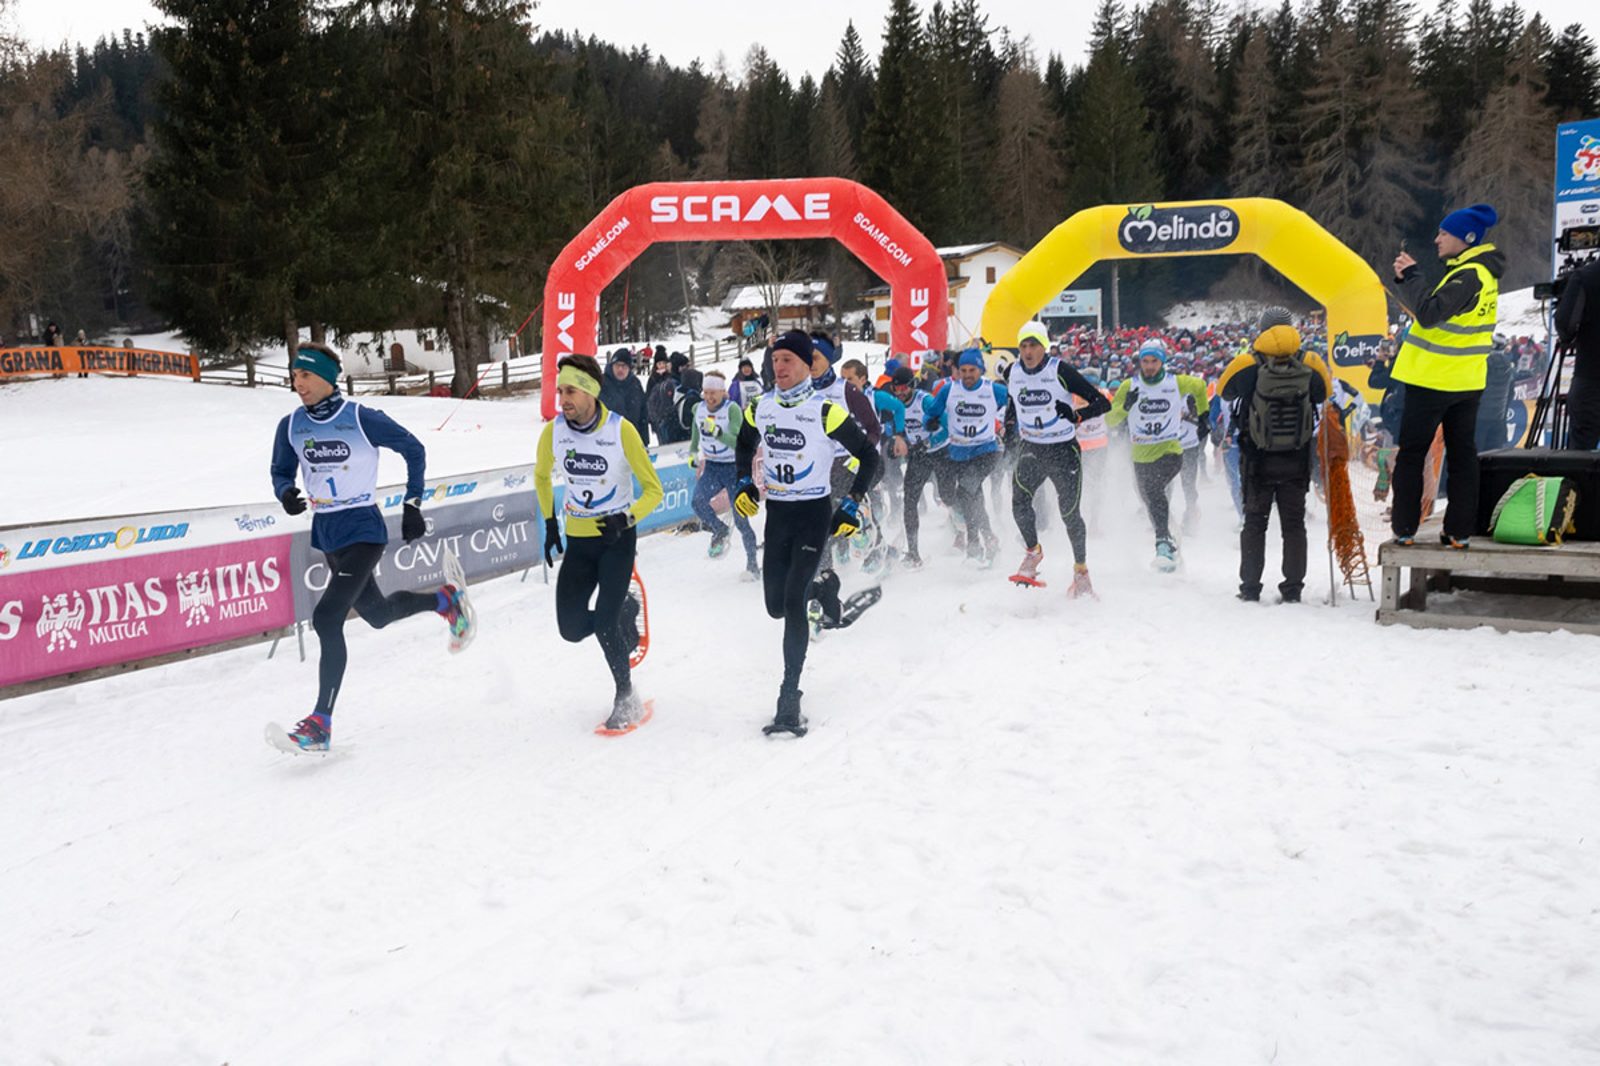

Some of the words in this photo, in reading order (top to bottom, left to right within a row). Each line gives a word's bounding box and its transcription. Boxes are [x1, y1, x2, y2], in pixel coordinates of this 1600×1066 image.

[650, 192, 831, 223] SCAME
[574, 216, 631, 271] SCAME.COM
[853, 211, 913, 268] SCAME.COM
[77, 350, 193, 375] TRENTINGRANA
[765, 433, 804, 447] Melinda
[962, 425, 977, 438] 10
[304, 444, 349, 459] Melinda
[565, 458, 606, 471] Melinda
[775, 463, 795, 484] 18
[326, 477, 337, 497] 1
[582, 489, 594, 509] 2
[470, 520, 529, 553] CAVIT
[16, 538, 53, 560] LA
[394, 534, 463, 571] CAVIT
[491, 552, 518, 565] TRENTO
[215, 556, 281, 602] ITAS
[87, 577, 168, 626] ITAS
[219, 597, 268, 620] MUTUA
[89, 620, 149, 645] MUTUA
